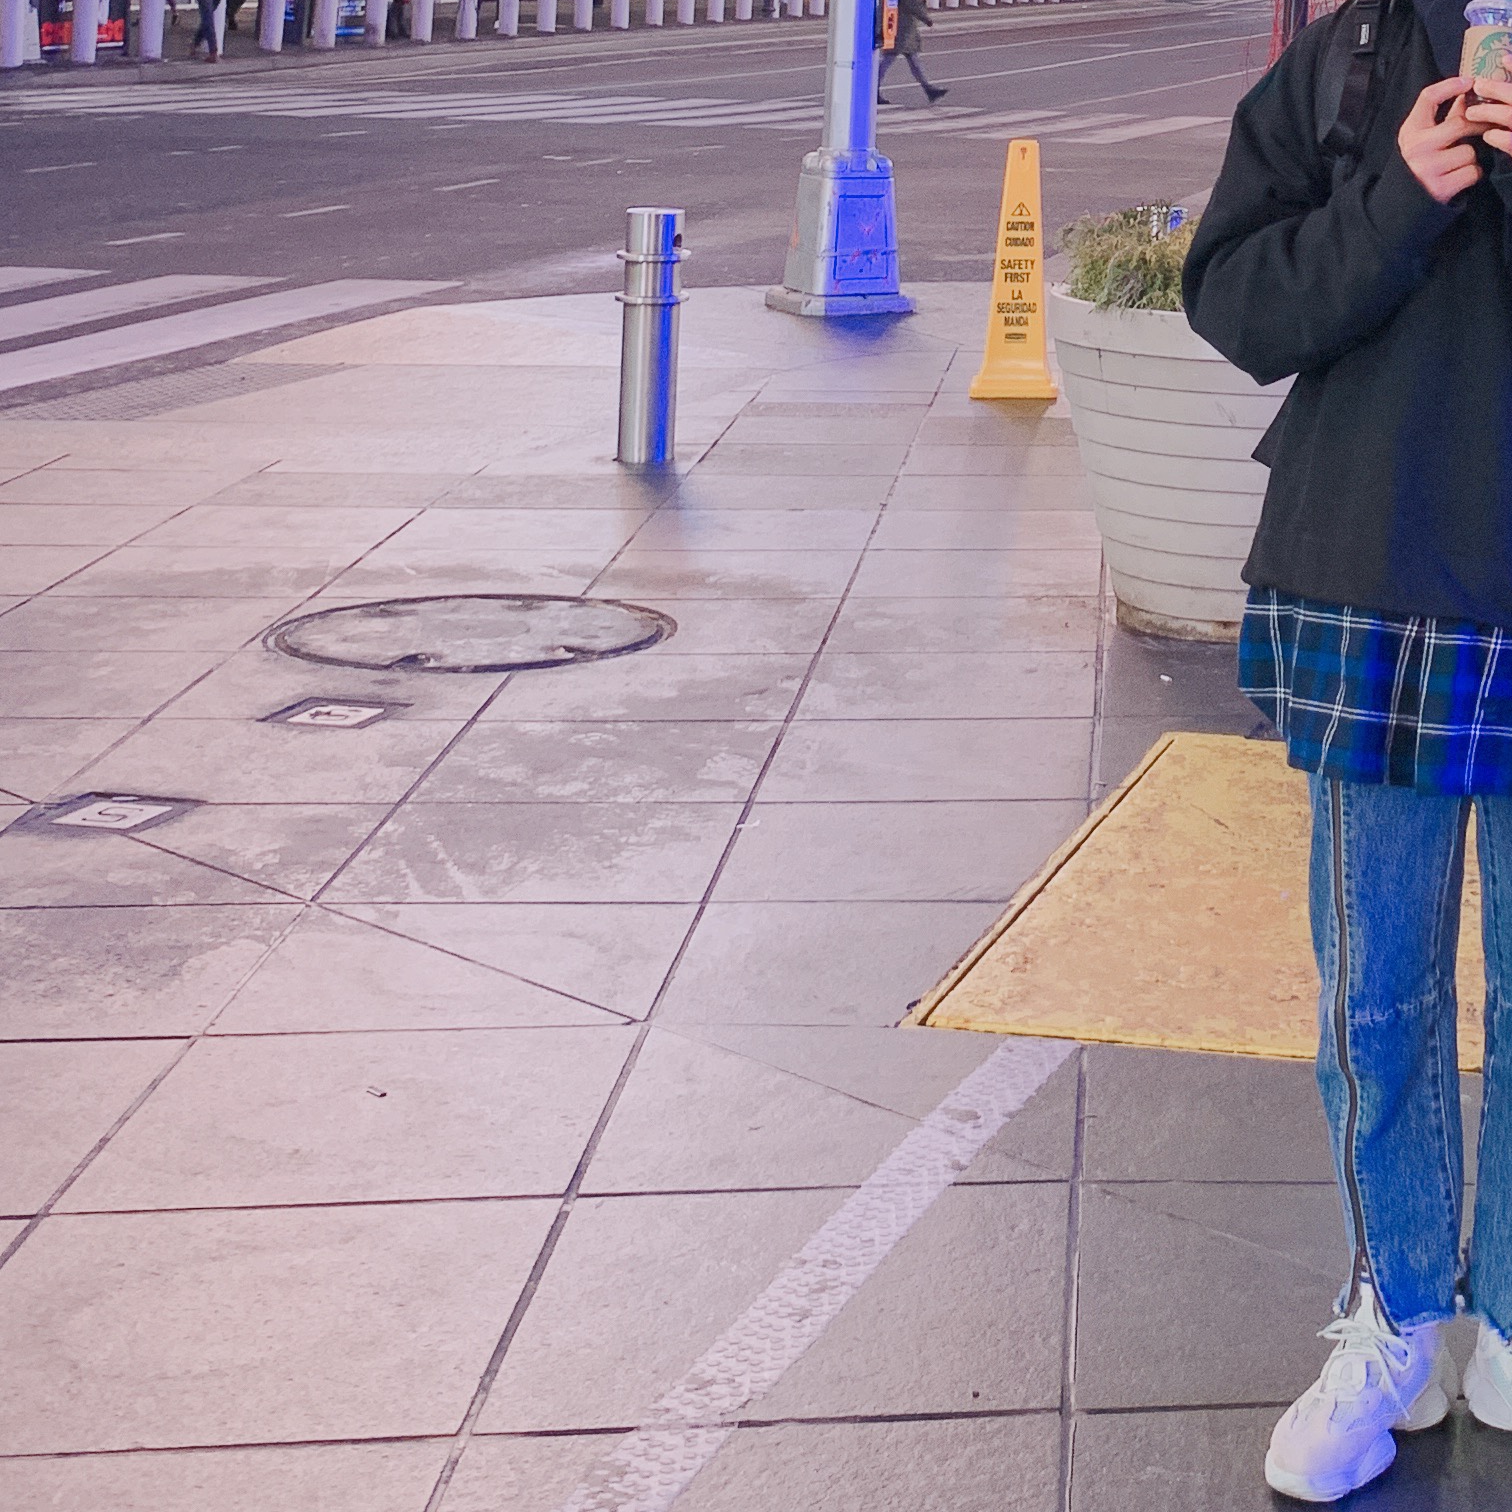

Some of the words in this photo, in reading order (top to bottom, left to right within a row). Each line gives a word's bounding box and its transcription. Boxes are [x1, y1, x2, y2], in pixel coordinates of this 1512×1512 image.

[1006, 221, 1035, 232] CAUTION
[1005, 237, 1035, 248] CUIDADO
[1000, 259, 1036, 271] SAFETY
[1004, 272, 1031, 284] FIRST
[1011, 289, 1023, 301] LA
[996, 302, 1037, 314] SEGURIDAD
[1003, 316, 1030, 327] MANDA
